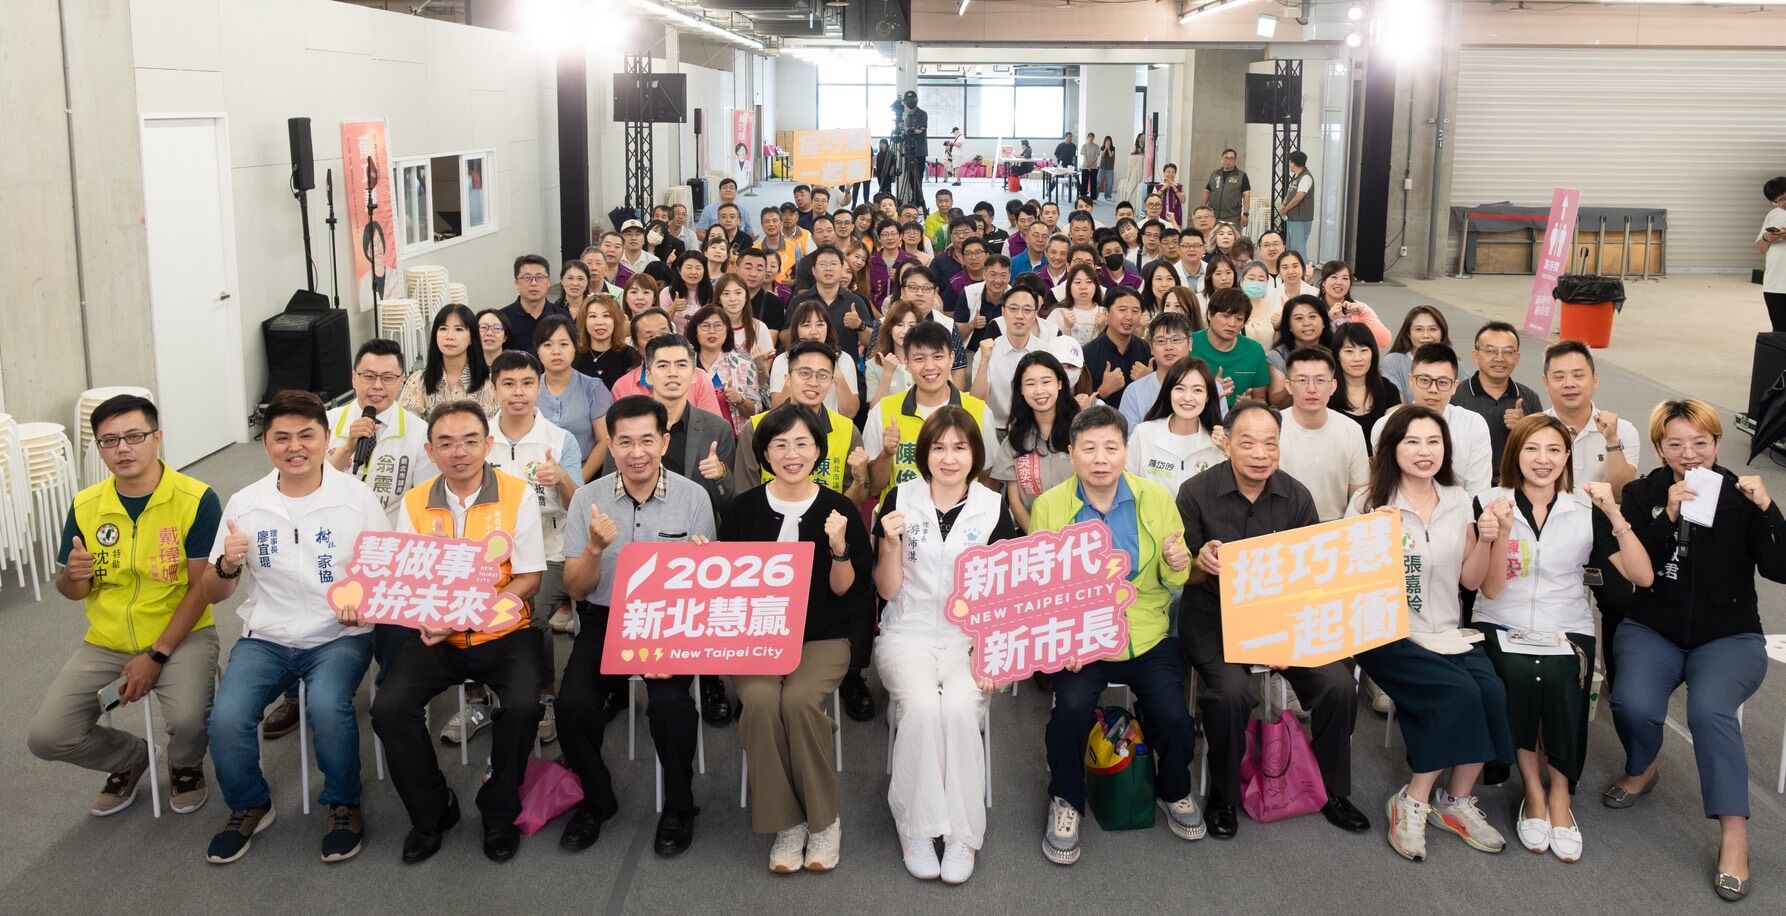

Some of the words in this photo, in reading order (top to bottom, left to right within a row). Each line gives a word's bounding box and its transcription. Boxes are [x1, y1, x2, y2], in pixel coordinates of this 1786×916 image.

[256, 530, 271, 568] 廖宜琨
[269, 529, 278, 554] 理事長
[920, 522, 930, 543] 理事長
[112, 548, 120, 569] 特助
[317, 553, 334, 583] 家協
[351, 535, 482, 586] 慧做事
[663, 553, 795, 590] 2026
[963, 530, 1102, 601] 新時代
[1231, 514, 1393, 605] 挺巧慧
[970, 607, 1008, 625] NEW
[1014, 592, 1071, 615] TAIPEI
[1075, 583, 1116, 601] CITY
[1403, 555, 1423, 614] 張嘉玲
[622, 595, 791, 640] 新北慧贏
[1239, 587, 1402, 660] 一起衝
[669, 648, 701, 660] New
[704, 647, 749, 661] Taipei
[752, 645, 784, 660] City
[983, 606, 1119, 677] 新市長
